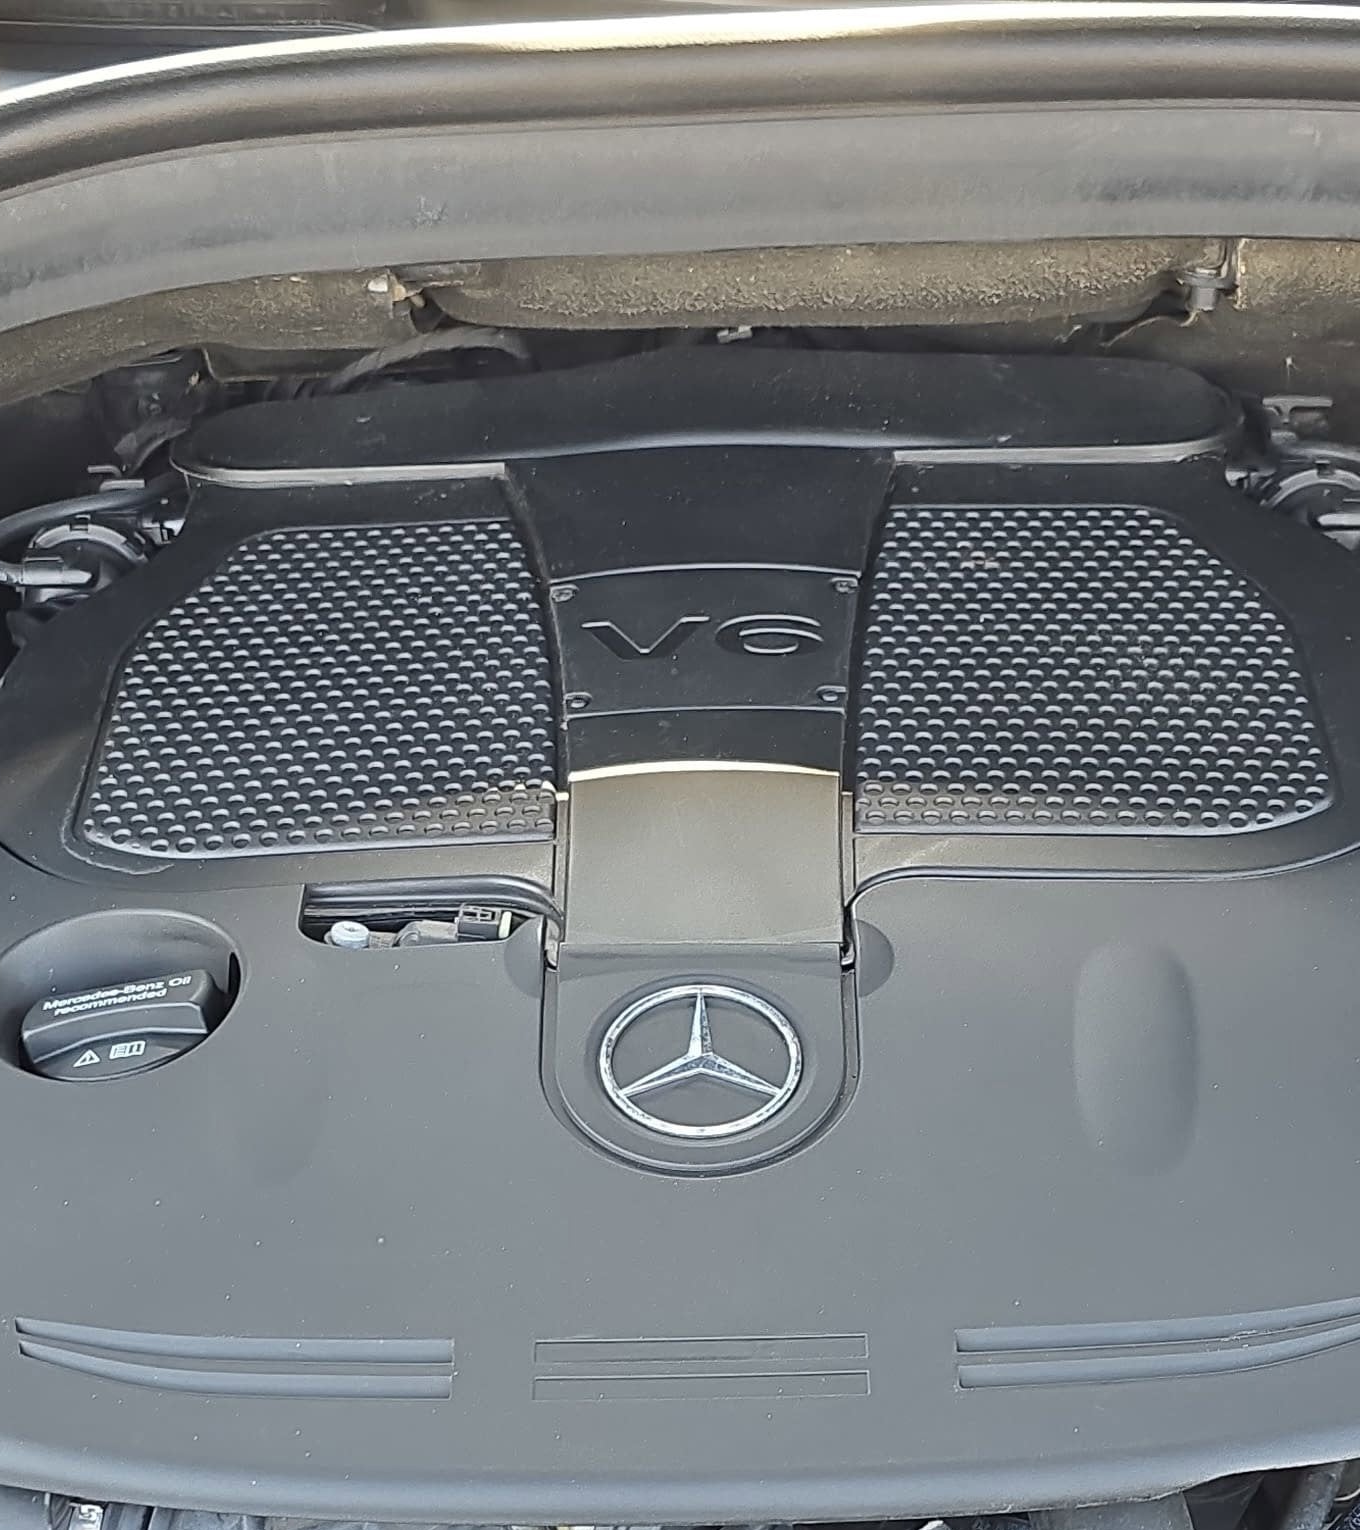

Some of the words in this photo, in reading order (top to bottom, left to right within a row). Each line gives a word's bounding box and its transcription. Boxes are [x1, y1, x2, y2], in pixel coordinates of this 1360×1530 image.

[580, 613, 824, 662] V6
[42, 980, 165, 1011] Mercedes-Benz
[167, 975, 193, 987] Oil
[53, 988, 168, 1017] recommended
